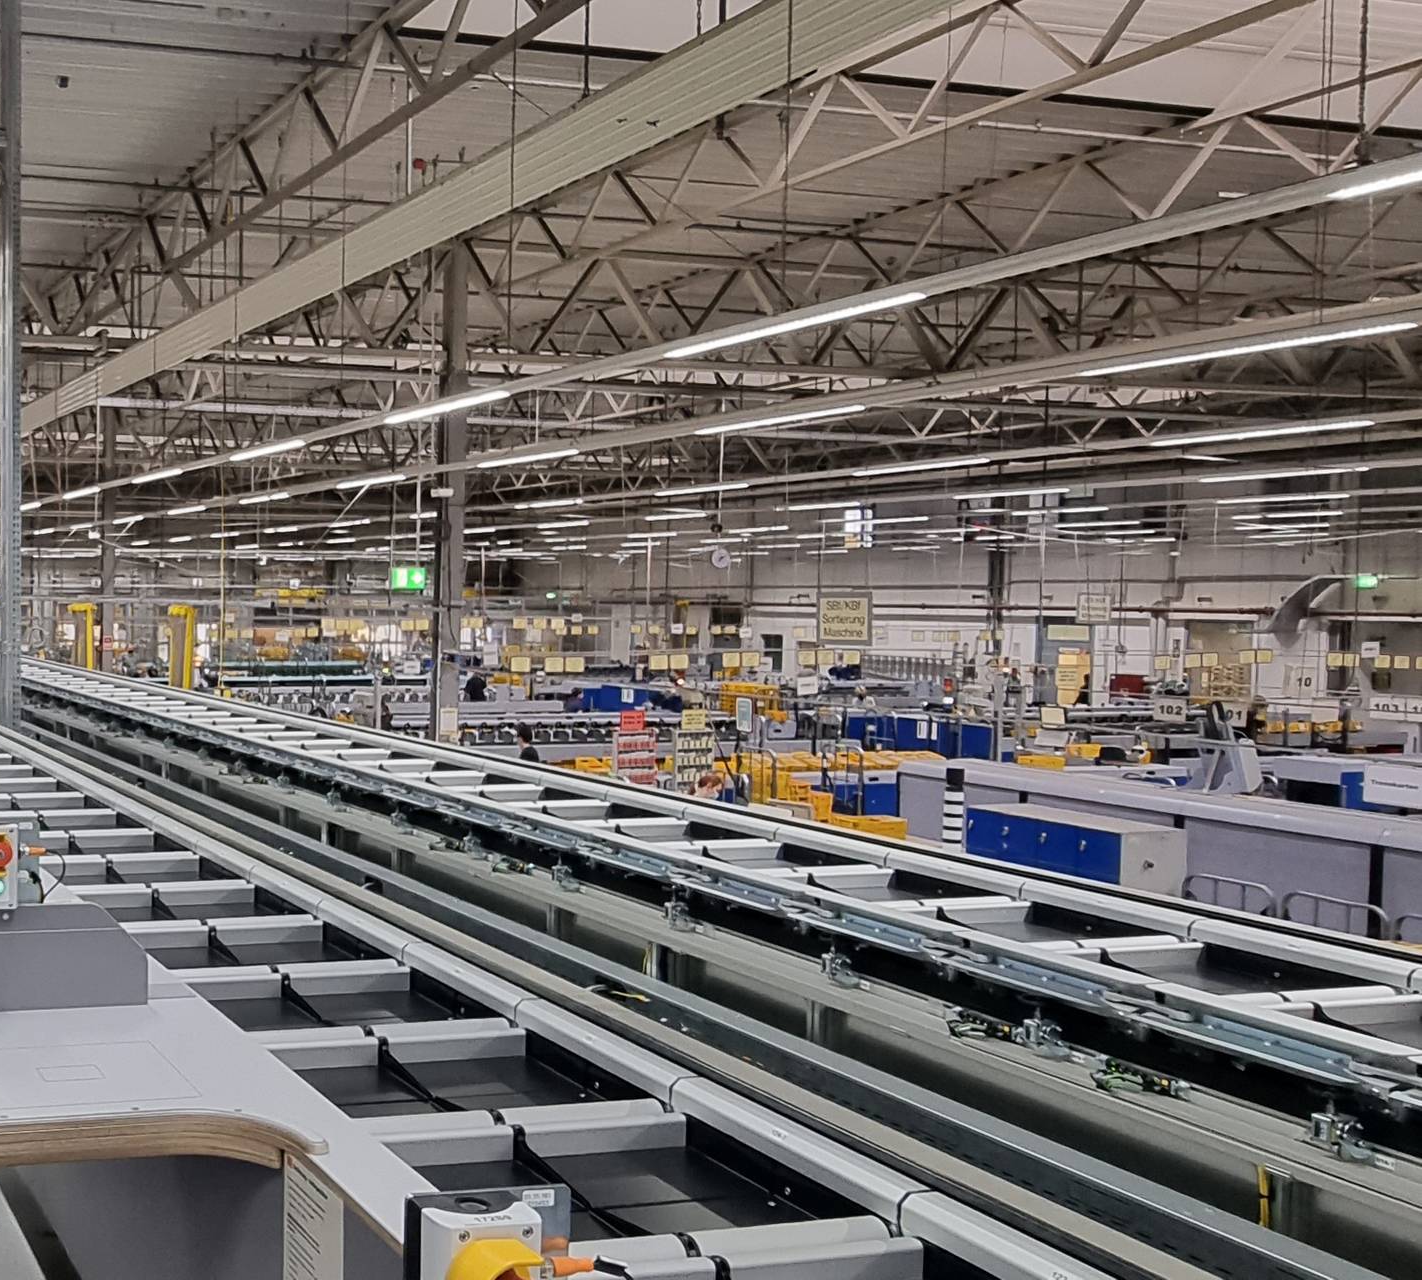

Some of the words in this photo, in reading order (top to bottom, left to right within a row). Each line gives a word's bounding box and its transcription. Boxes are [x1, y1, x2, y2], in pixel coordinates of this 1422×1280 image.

[822, 613, 866, 627] Sortierung
[823, 627, 863, 638] Maschine
[1159, 704, 1183, 716] 102
